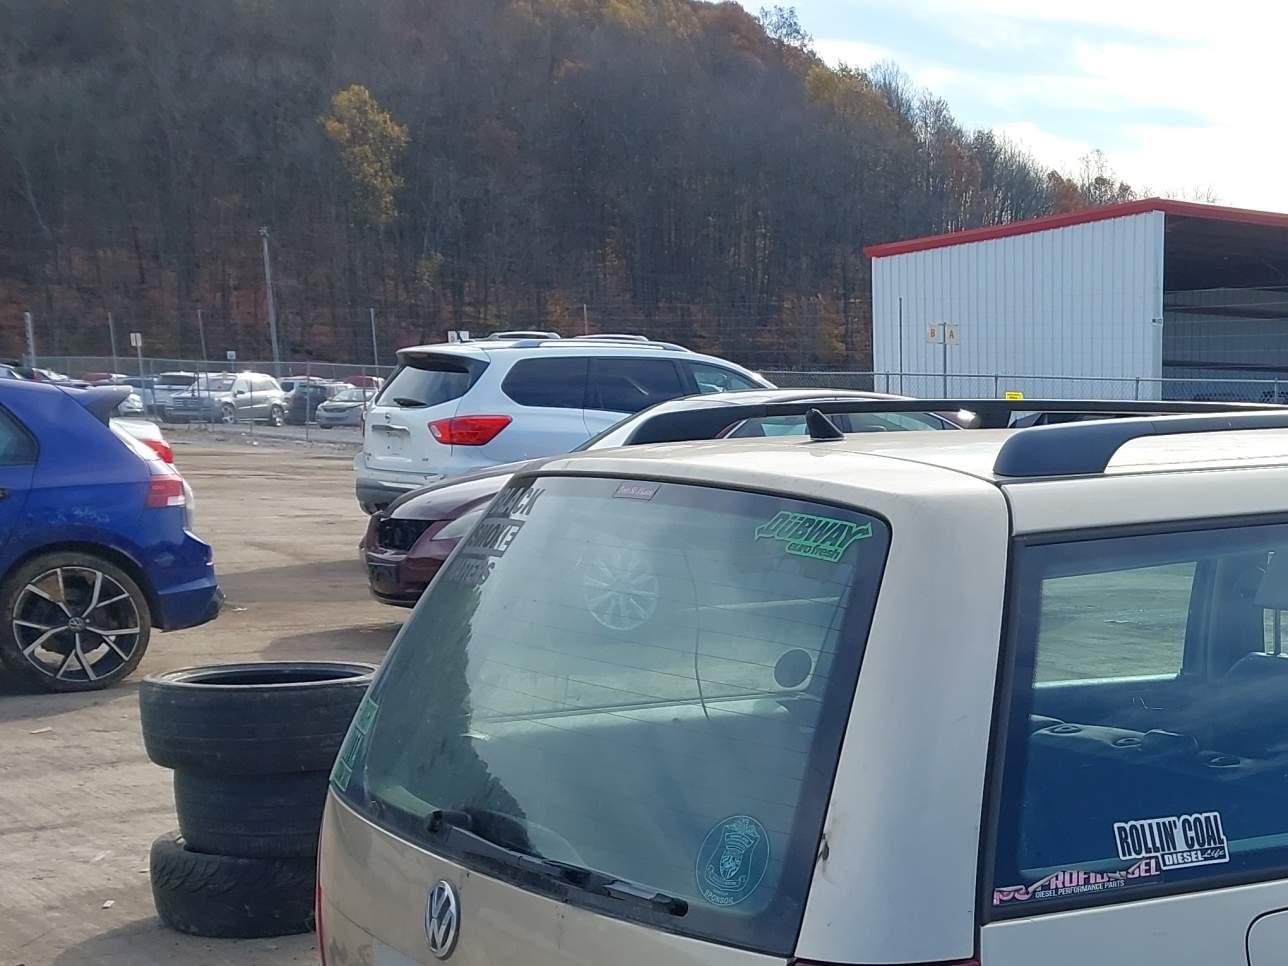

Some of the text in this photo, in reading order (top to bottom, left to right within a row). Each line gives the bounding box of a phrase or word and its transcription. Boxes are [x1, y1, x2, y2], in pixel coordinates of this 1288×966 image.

[811, 544, 841, 560] fresh
[1117, 814, 1225, 858] ROLLIN' COAL
[1165, 850, 1204, 865] DIESEL
[1035, 888, 1057, 898] DIESEL
[1058, 883, 1104, 897] PERFORMANCE
[1104, 880, 1125, 890] PARTS
